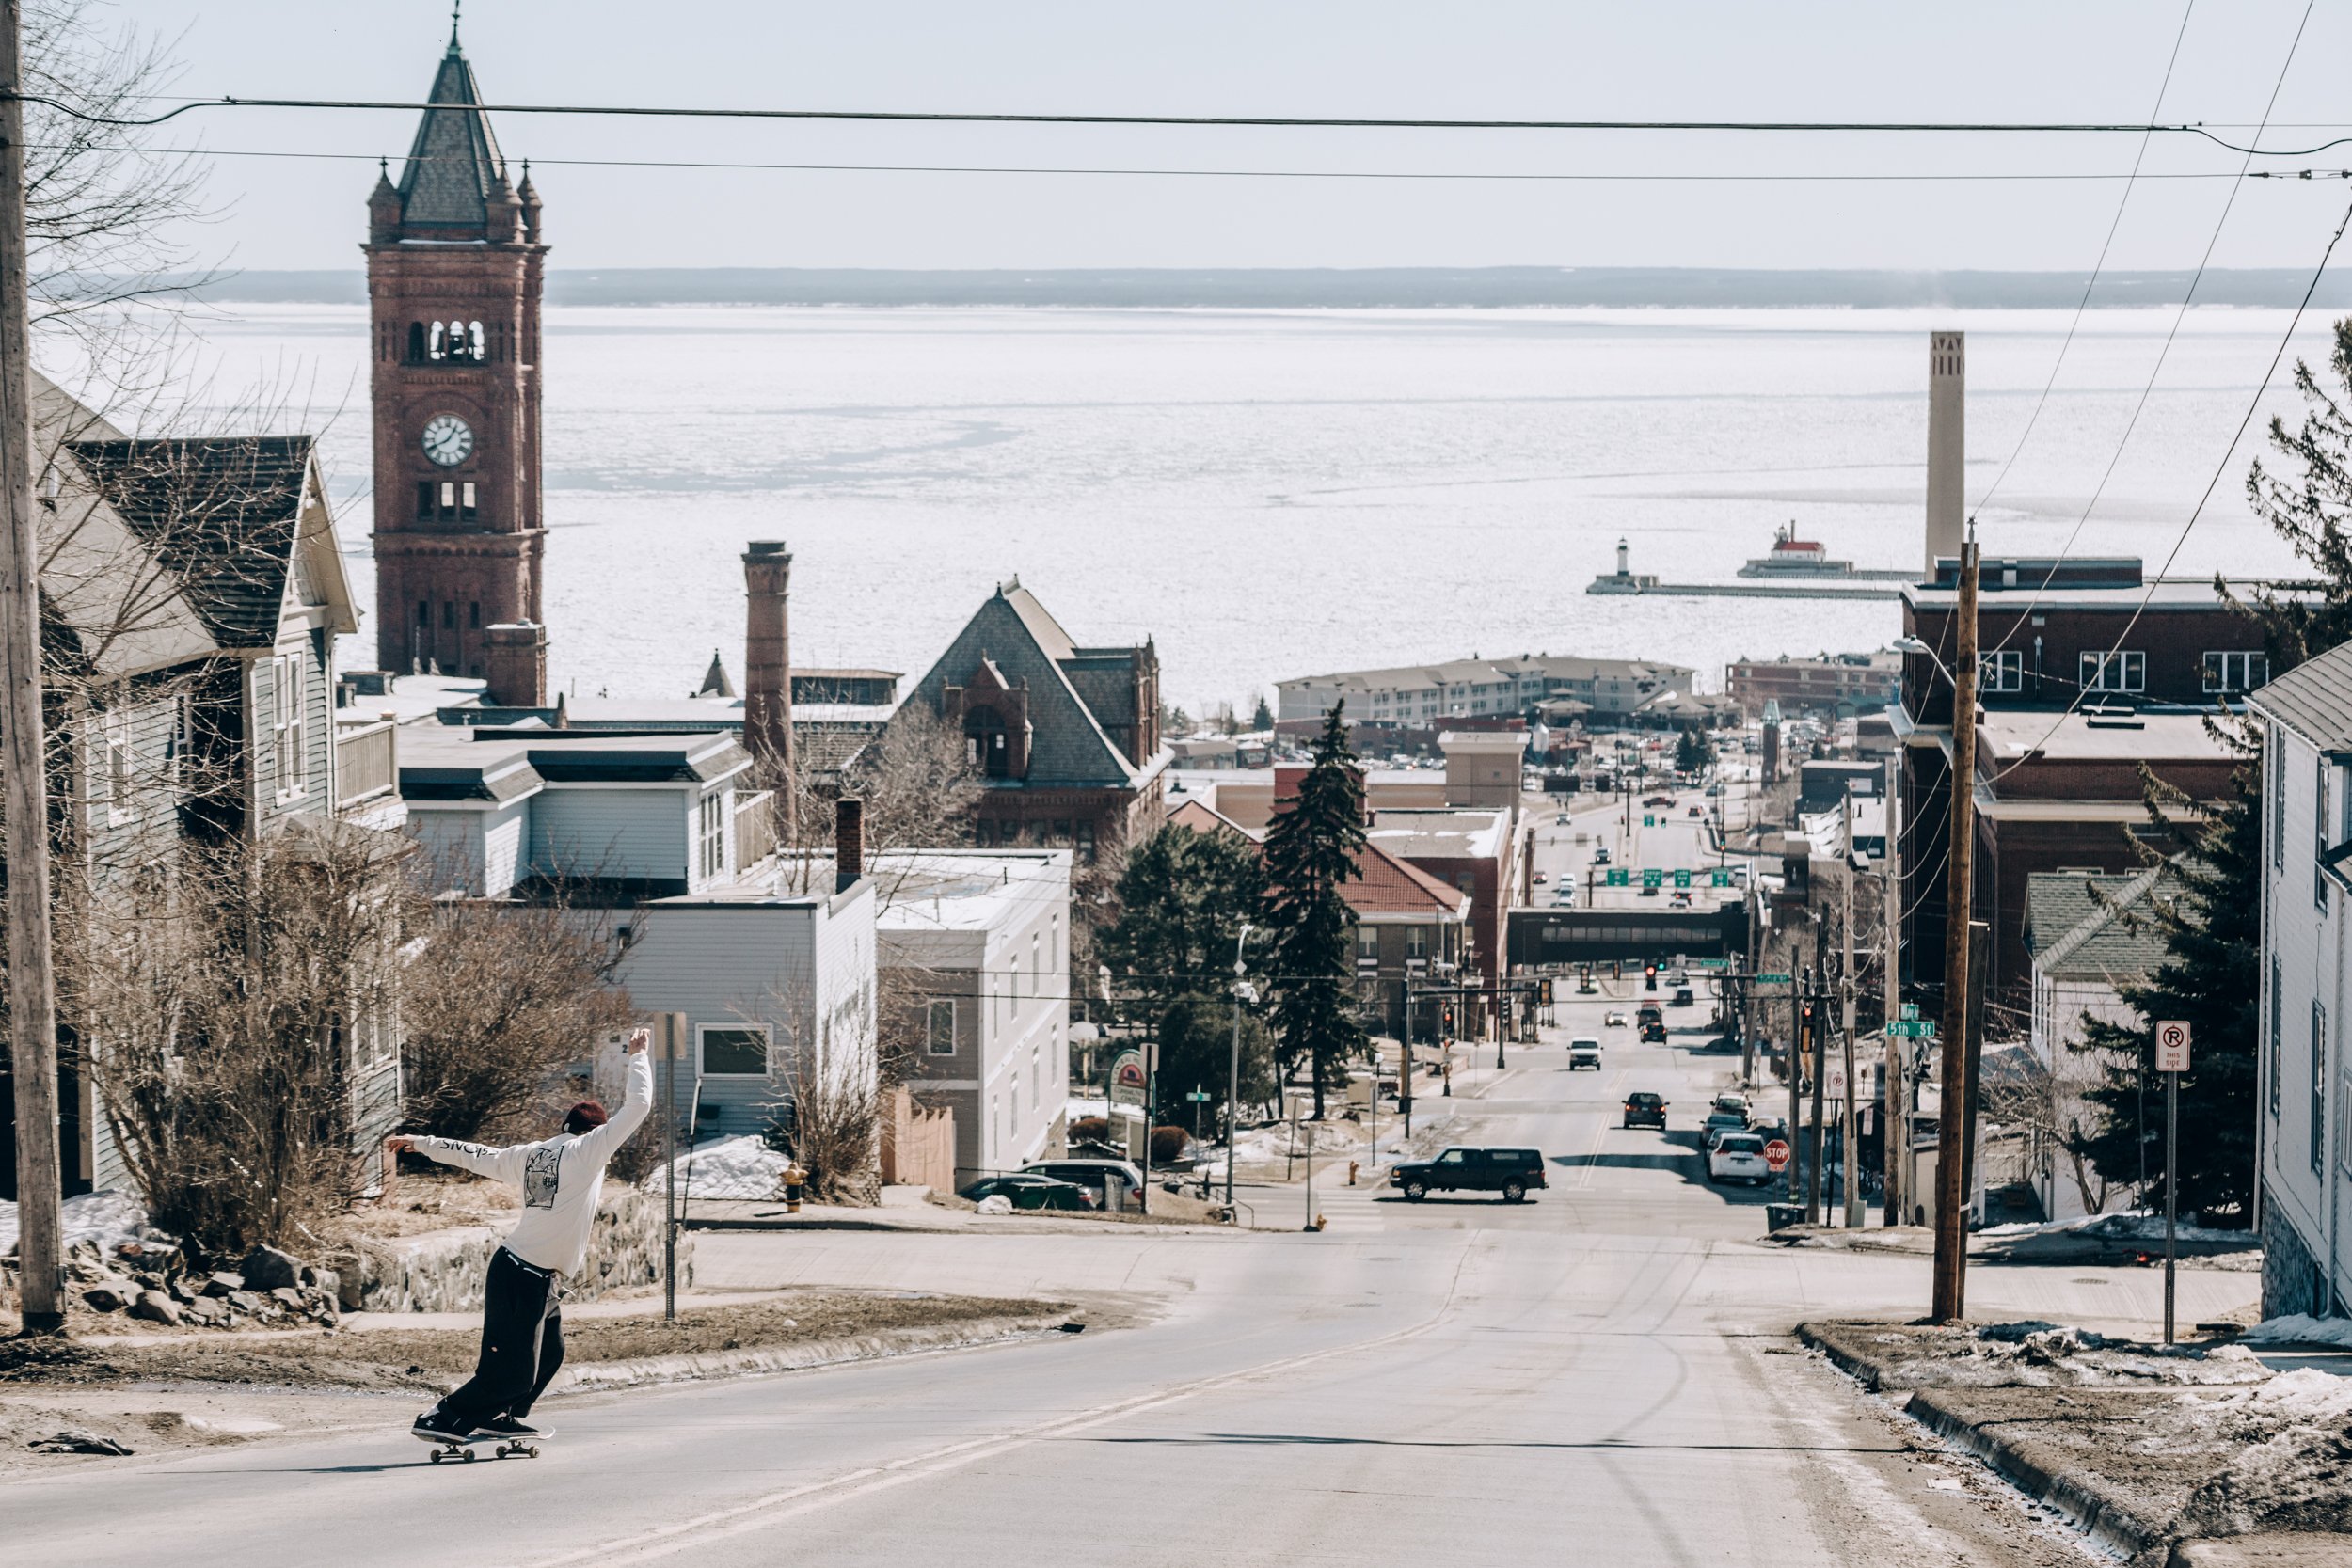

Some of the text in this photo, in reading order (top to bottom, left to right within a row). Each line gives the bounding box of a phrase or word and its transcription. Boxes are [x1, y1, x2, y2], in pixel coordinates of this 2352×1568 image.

[1890, 1022, 1931, 1036] 5th St
[1766, 1147, 1788, 1159] STOP
